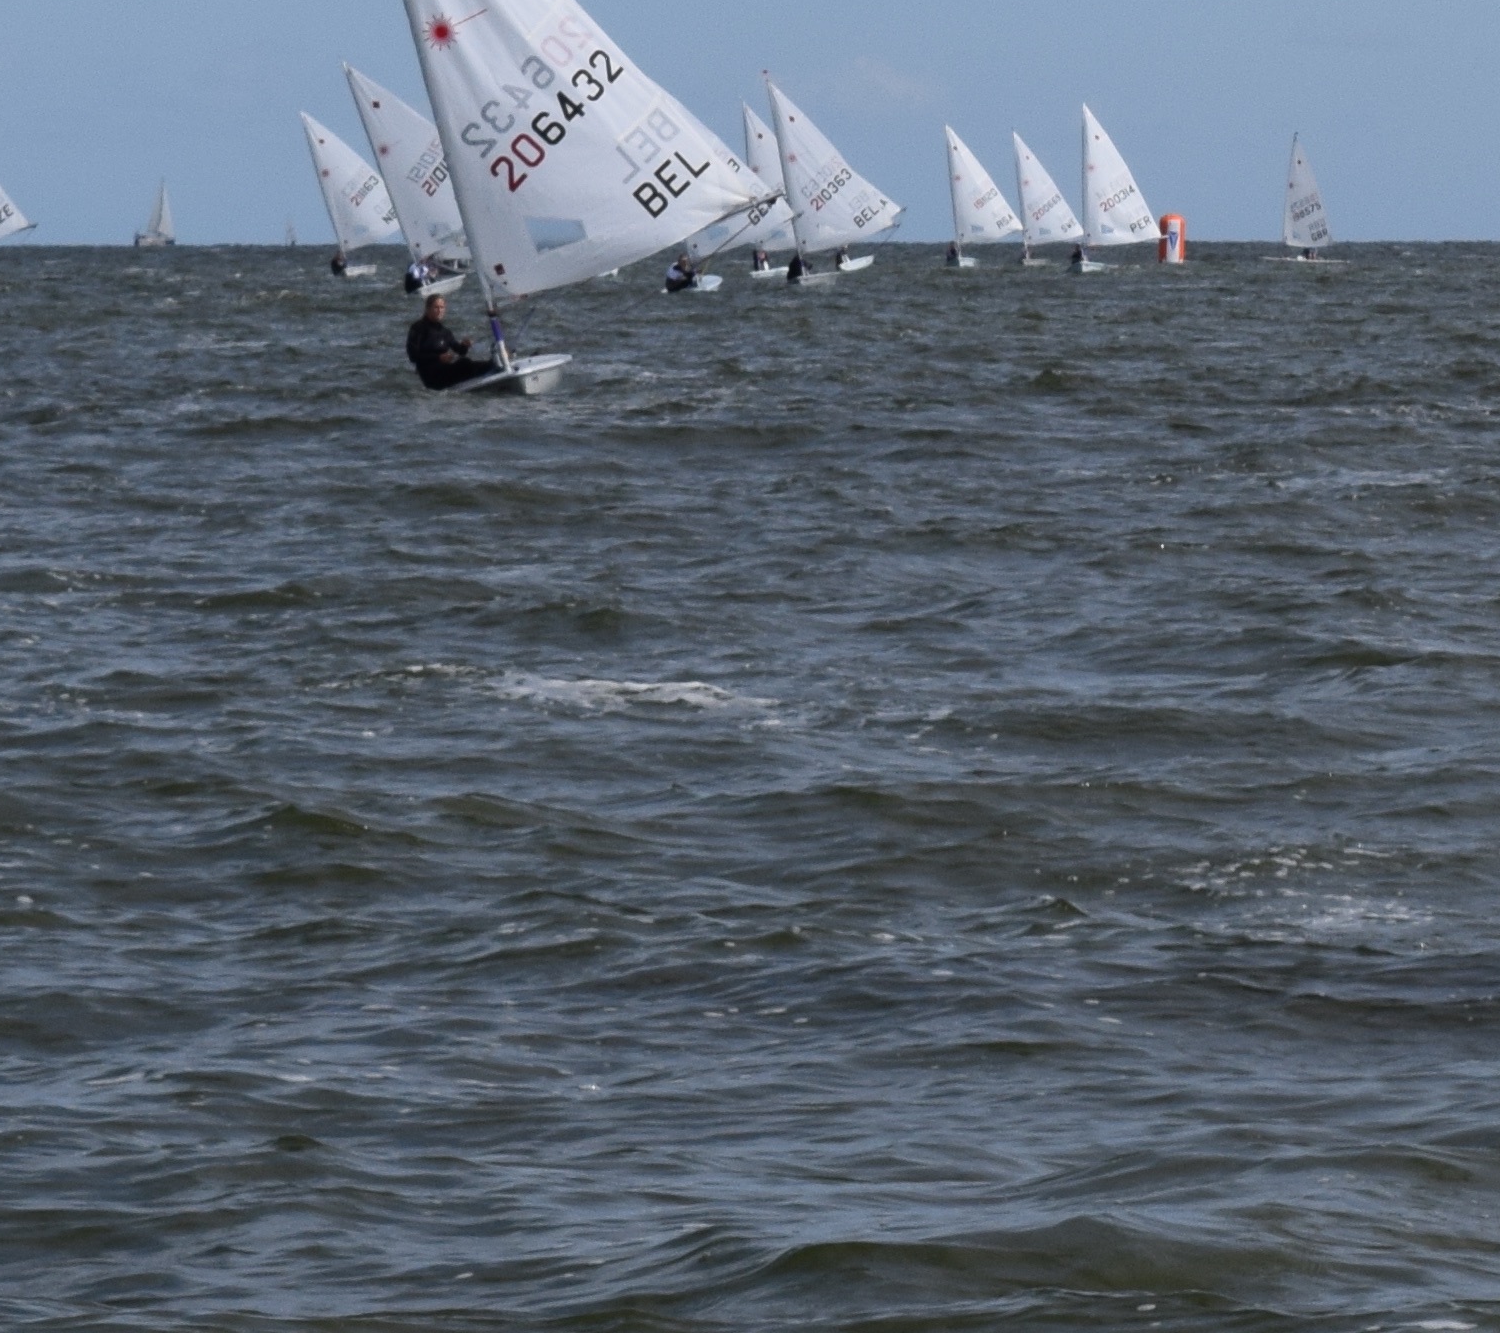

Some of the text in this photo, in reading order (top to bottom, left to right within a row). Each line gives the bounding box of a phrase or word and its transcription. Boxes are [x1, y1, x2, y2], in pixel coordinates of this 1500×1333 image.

[490, 50, 624, 193] 206432
[421, 158, 449, 197] 2101
[632, 151, 711, 219] BEL
[810, 168, 853, 211] 210363
[747, 196, 777, 226] GE
[1129, 215, 1152, 234] PER
